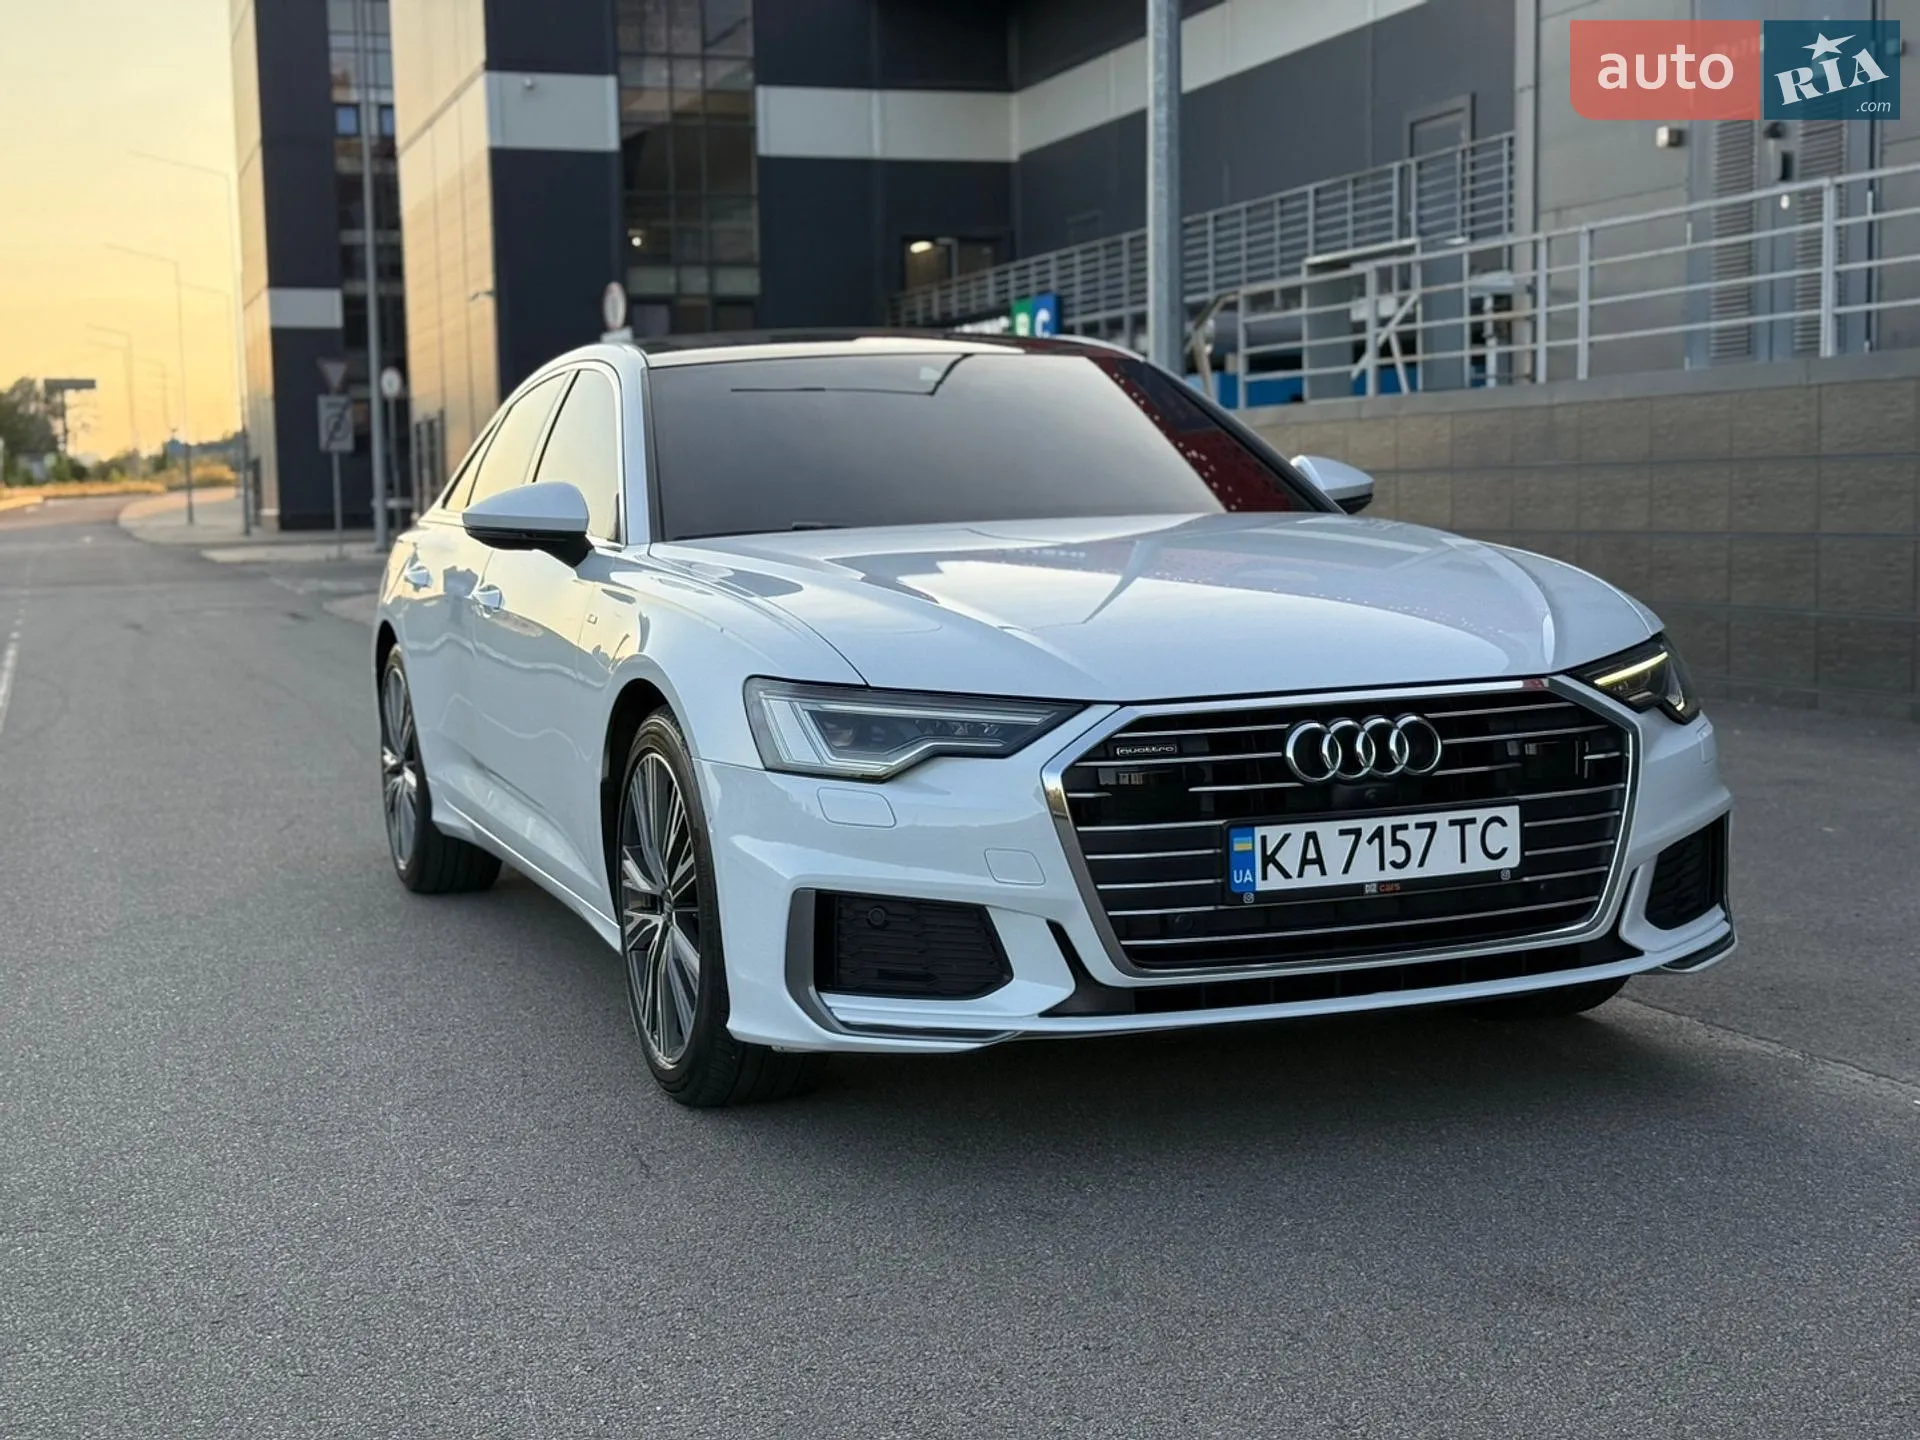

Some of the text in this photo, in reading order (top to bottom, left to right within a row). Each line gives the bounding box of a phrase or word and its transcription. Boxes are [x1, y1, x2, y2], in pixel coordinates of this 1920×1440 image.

[1259, 815, 1509, 882] KA 7157 TC
[1233, 868, 1253, 884] UA
